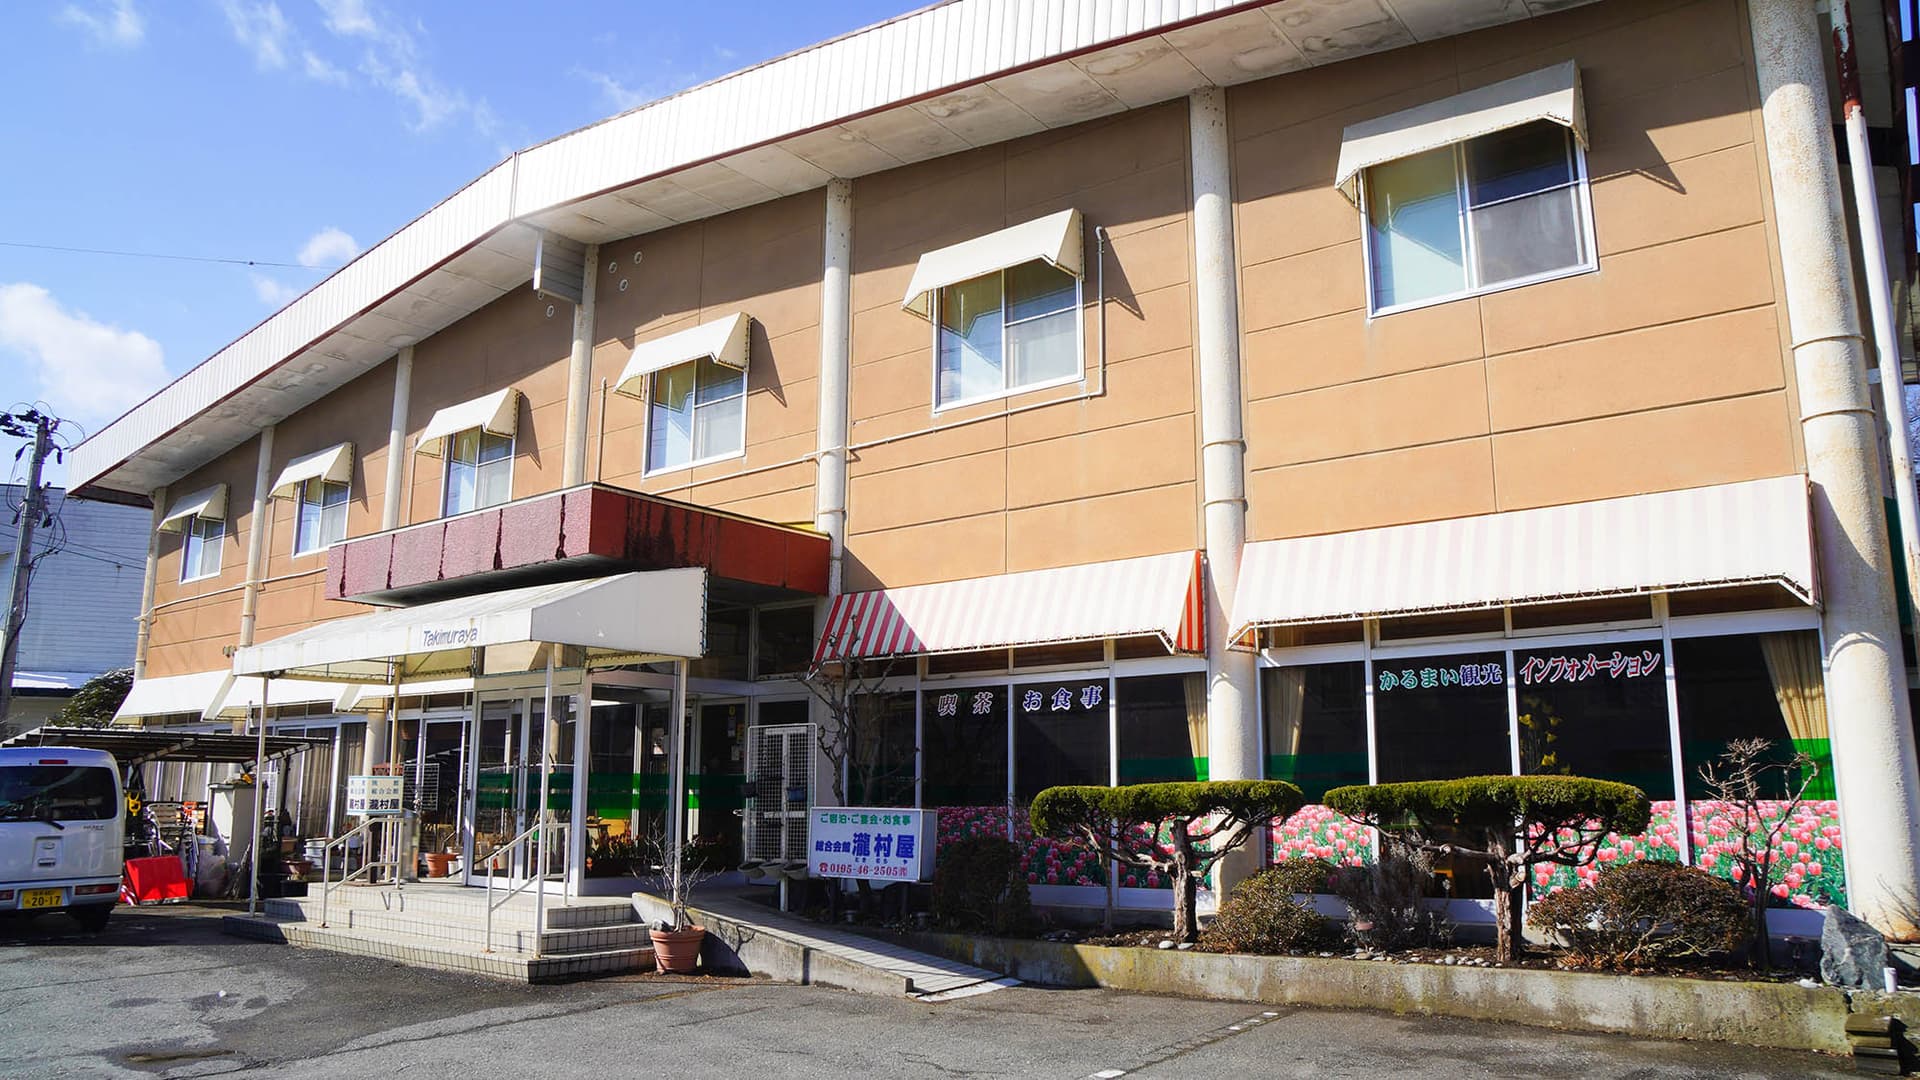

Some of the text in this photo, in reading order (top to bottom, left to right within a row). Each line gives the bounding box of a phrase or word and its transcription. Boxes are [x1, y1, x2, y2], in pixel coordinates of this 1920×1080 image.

[424, 628, 478, 647] Takimuraya
[1379, 650, 1661, 691] かるまい観光 インフォメーション
[938, 685, 1103, 716] 喫茶 お食事
[815, 832, 915, 859] 総合会館 瀧村屋
[31, 895, 61, 907] 20-17
